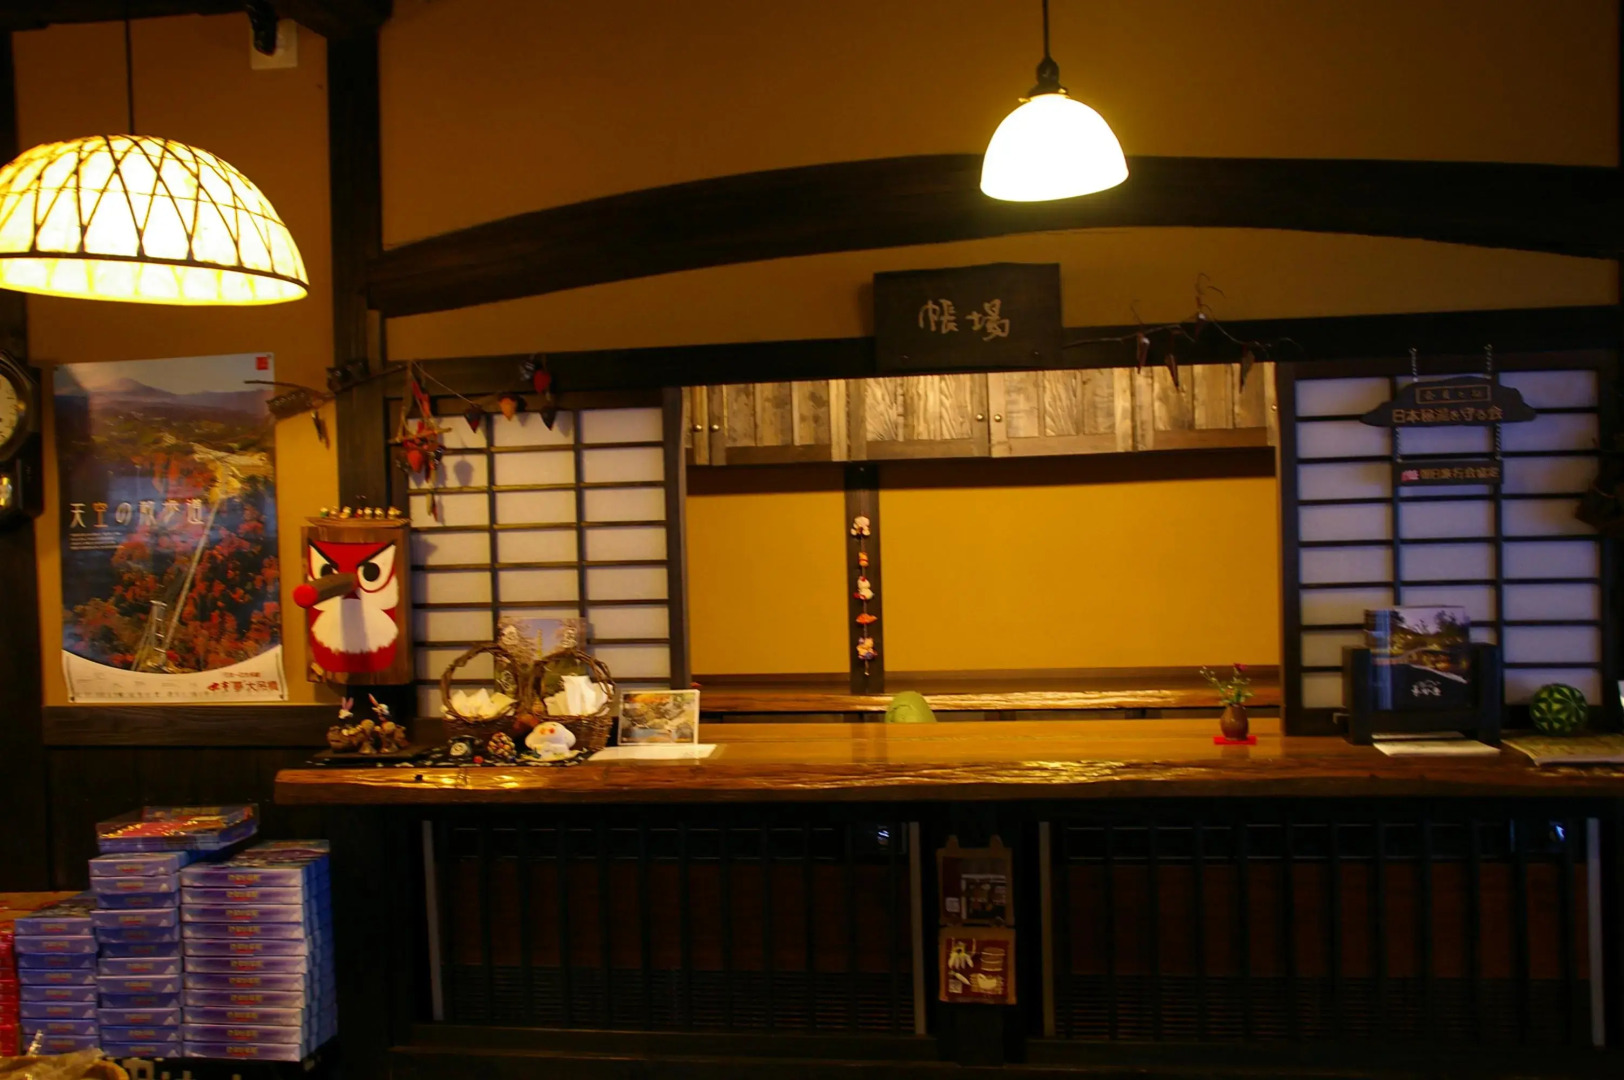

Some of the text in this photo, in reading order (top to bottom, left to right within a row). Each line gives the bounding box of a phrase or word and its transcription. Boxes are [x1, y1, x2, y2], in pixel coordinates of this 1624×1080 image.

[918, 298, 1010, 342] 帳場
[69, 499, 205, 529] 天空の散歩道
